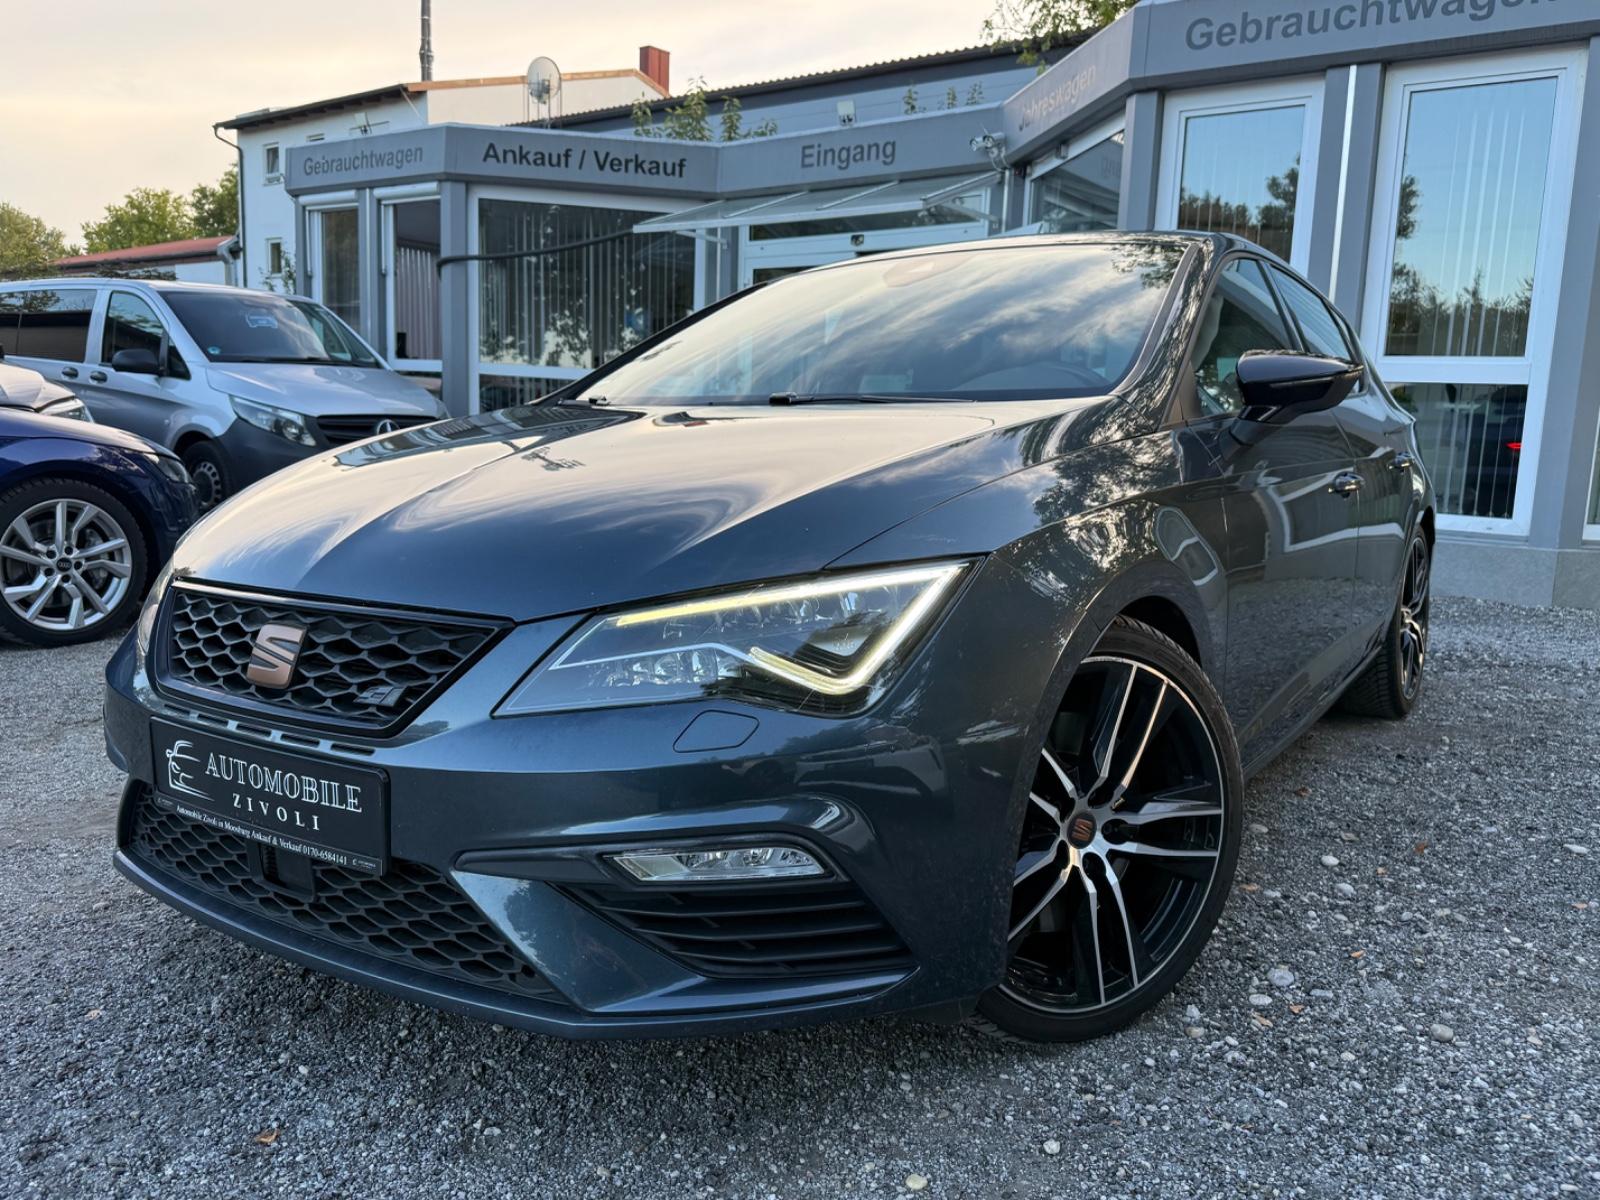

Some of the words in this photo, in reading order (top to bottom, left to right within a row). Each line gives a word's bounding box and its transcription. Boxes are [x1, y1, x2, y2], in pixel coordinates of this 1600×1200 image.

[1185, 0, 1555, 50] Gebrauchtwag
[303, 145, 424, 177] Gebrauchtwagen
[482, 142, 572, 169] Ankauf
[577, 149, 588, 171] /
[594, 150, 687, 179] Verkauf
[800, 139, 897, 171] Eingang
[204, 752, 363, 813] AUTOMOBILE
[176, 804, 203, 821] Automobile
[251, 829, 272, 844] Ankauf
[279, 837, 303, 853] Verkauf
[232, 792, 320, 831] ZIVOLI
